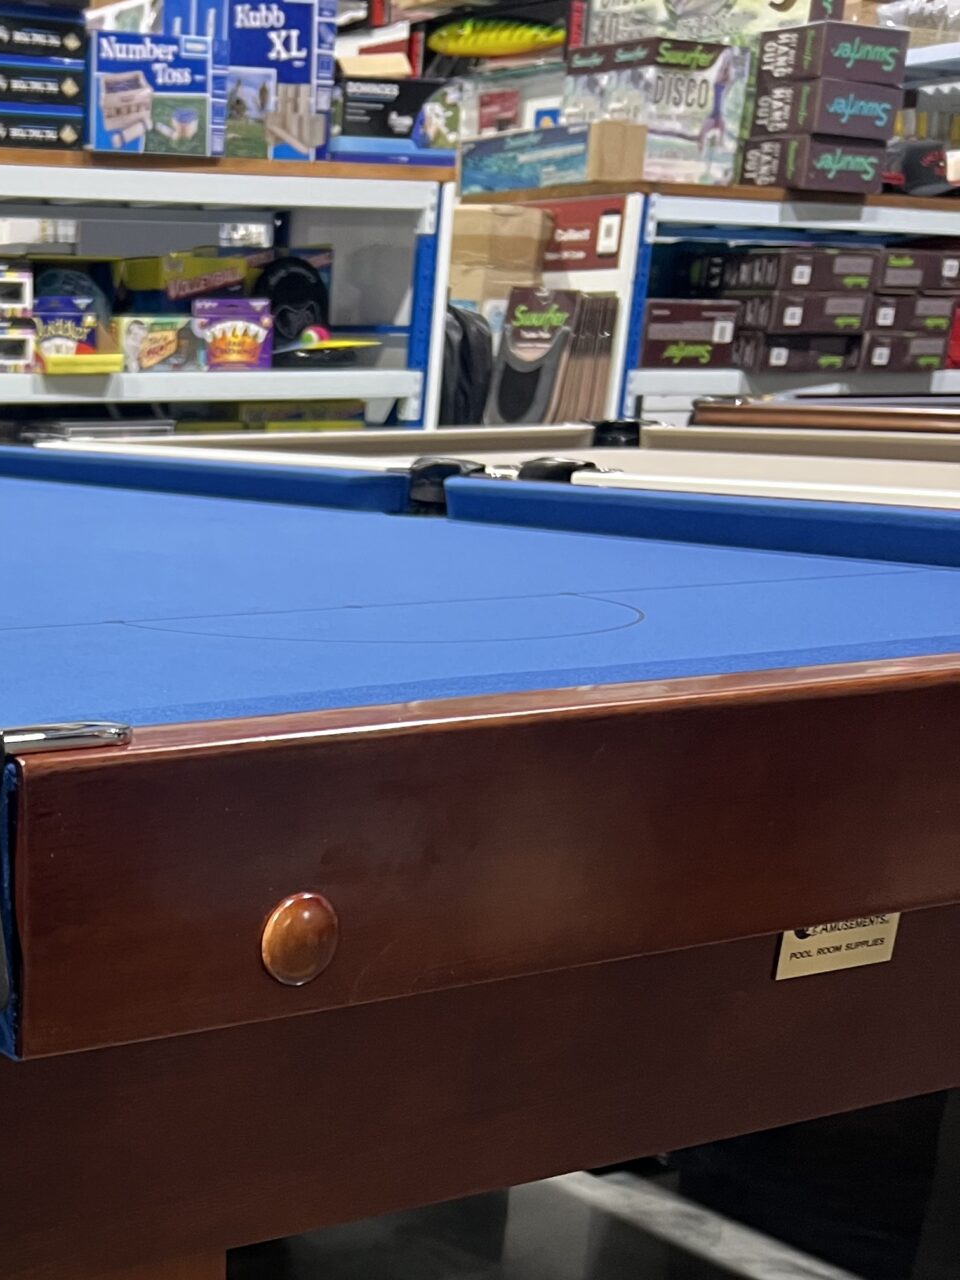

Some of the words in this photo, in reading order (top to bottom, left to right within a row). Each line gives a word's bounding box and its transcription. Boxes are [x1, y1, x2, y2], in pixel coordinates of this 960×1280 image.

[234, 3, 286, 29] Kubb
[100, 35, 178, 62] Number
[267, 28, 308, 61] XL
[655, 42, 715, 70] Swurfer
[761, 40, 778, 71] OUT
[772, 33, 791, 78] HANG
[831, 36, 899, 72] Swurfer
[151, 62, 192, 86] Toss
[652, 74, 710, 109] DISCO
[755, 96, 772, 126] OUT
[767, 87, 786, 132] HANG
[826, 92, 892, 127] Swurfer
[813, 147, 879, 181] Swurfer
[511, 304, 570, 333] Swurfer
[789, 949, 813, 961] POOL
[816, 944, 843, 956] ROOM
[844, 937, 886, 952] SUPPLIES
